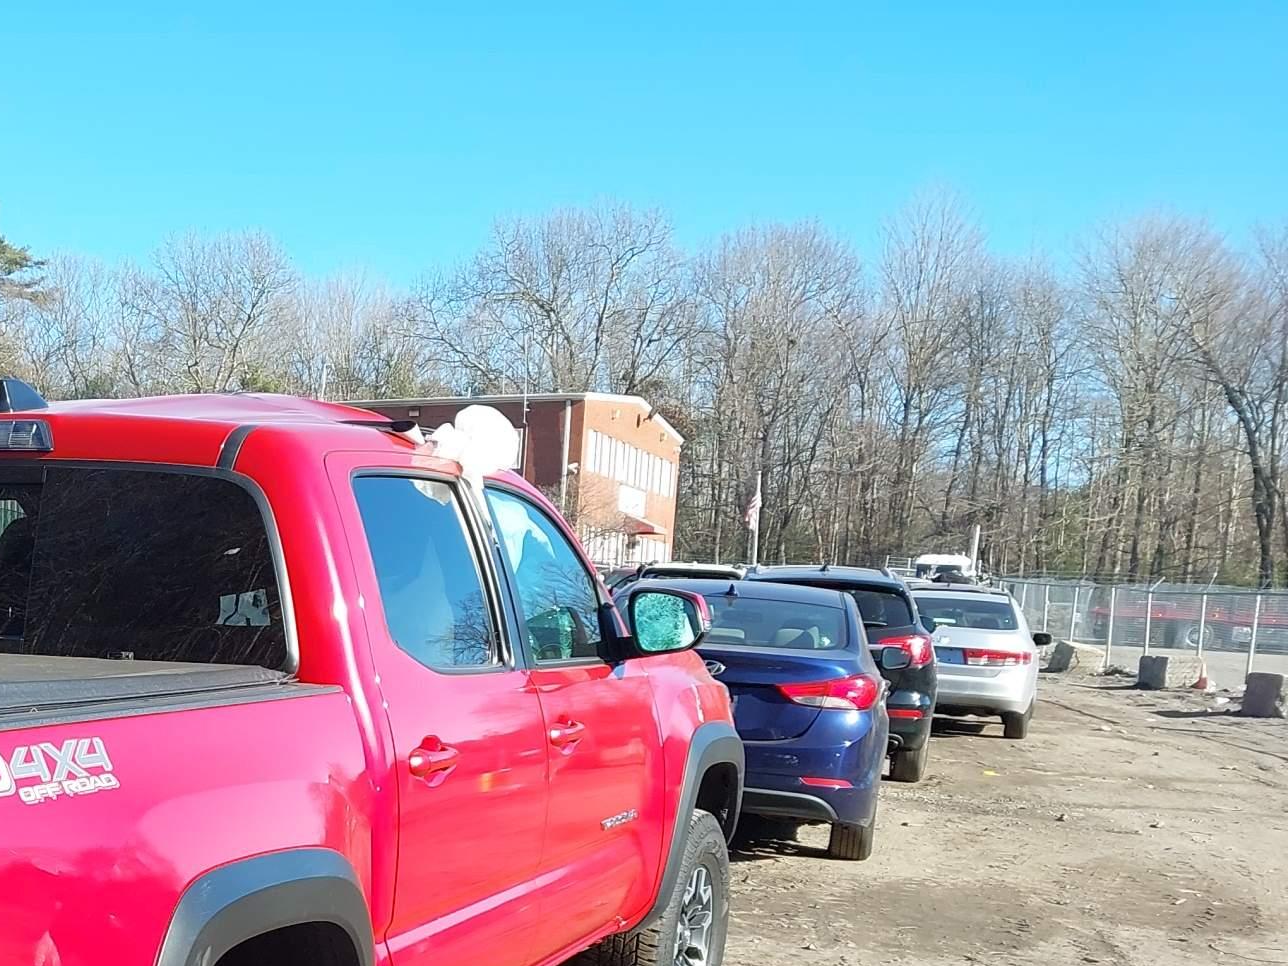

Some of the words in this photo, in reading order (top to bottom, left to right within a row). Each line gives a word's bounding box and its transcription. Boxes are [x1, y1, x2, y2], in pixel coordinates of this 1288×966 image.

[11, 737, 114, 782] 4X4
[18, 783, 64, 805] OFF
[64, 773, 120, 798] ROAD
